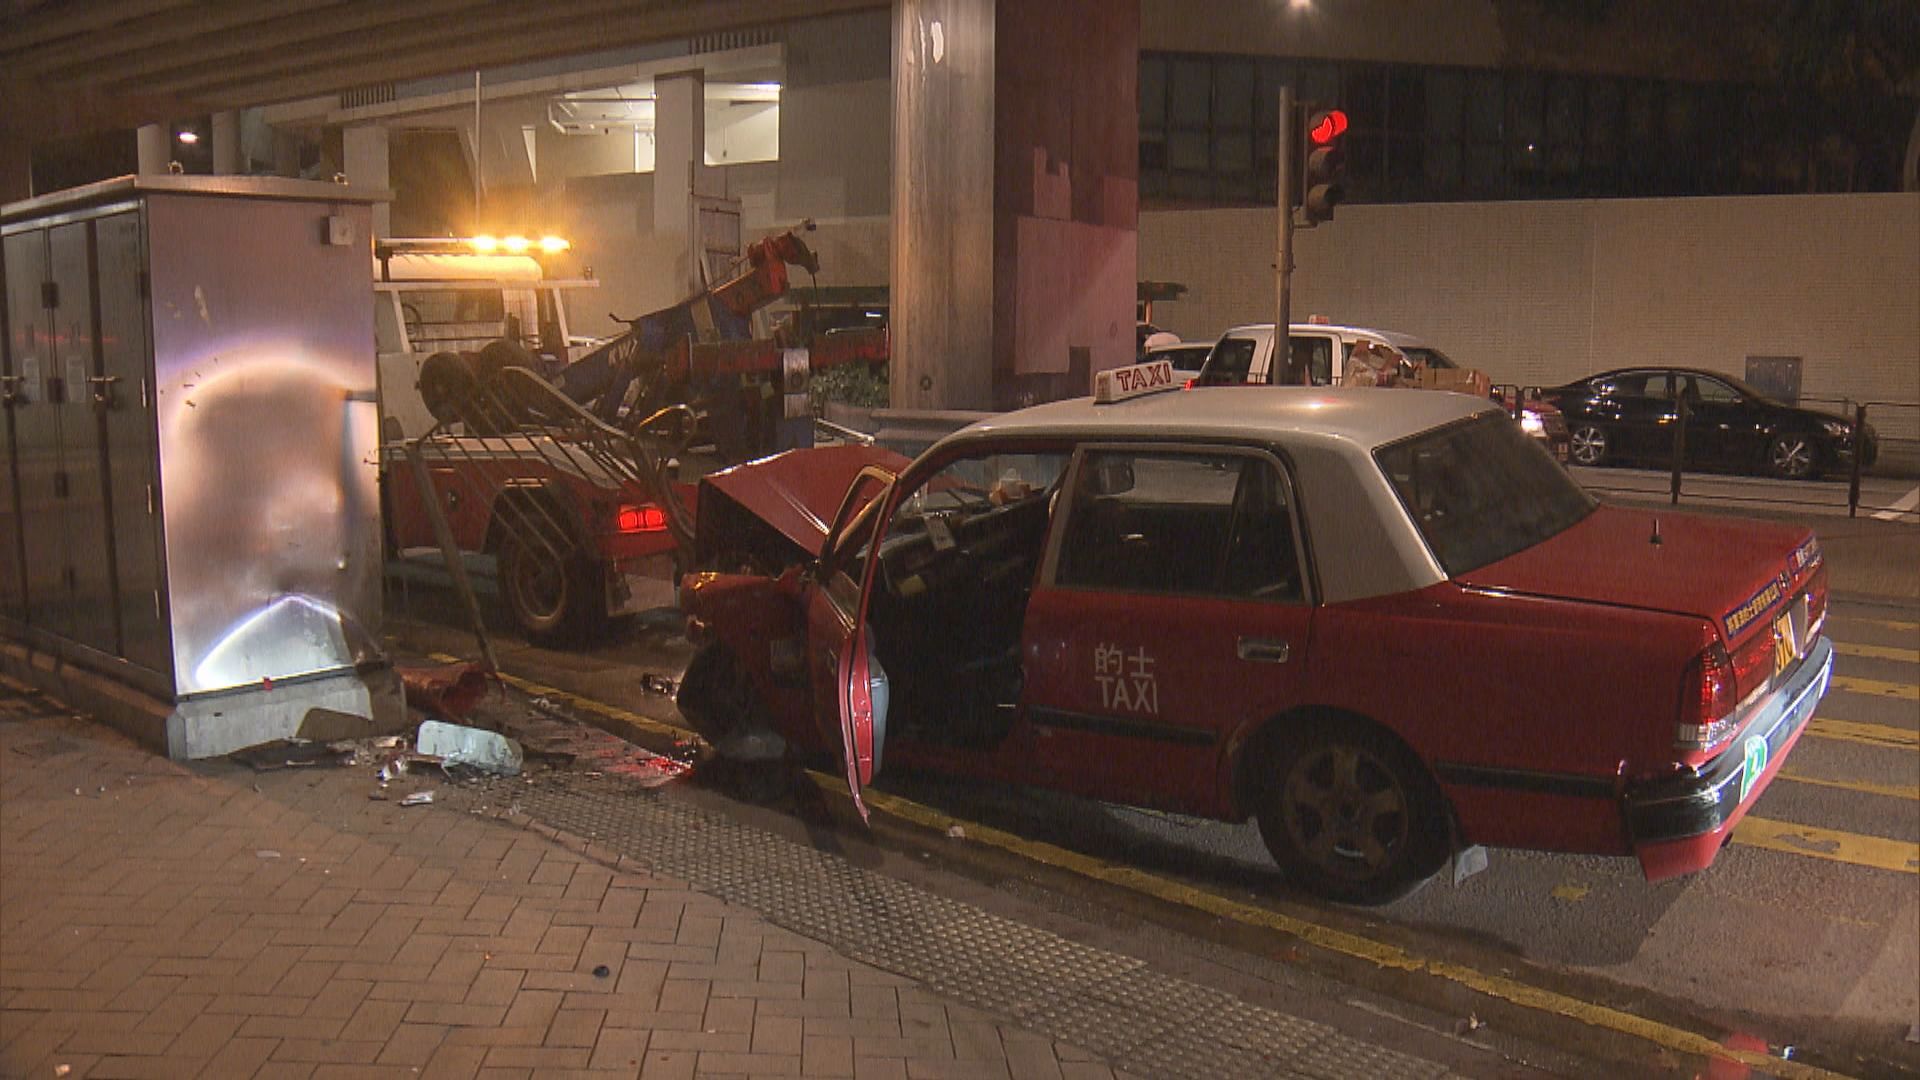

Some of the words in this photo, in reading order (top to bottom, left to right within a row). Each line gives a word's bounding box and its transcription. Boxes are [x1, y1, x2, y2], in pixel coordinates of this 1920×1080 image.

[1116, 362, 1171, 391] TAXI
[1095, 642, 1155, 679] 的士
[1095, 676, 1158, 714] TAXI
